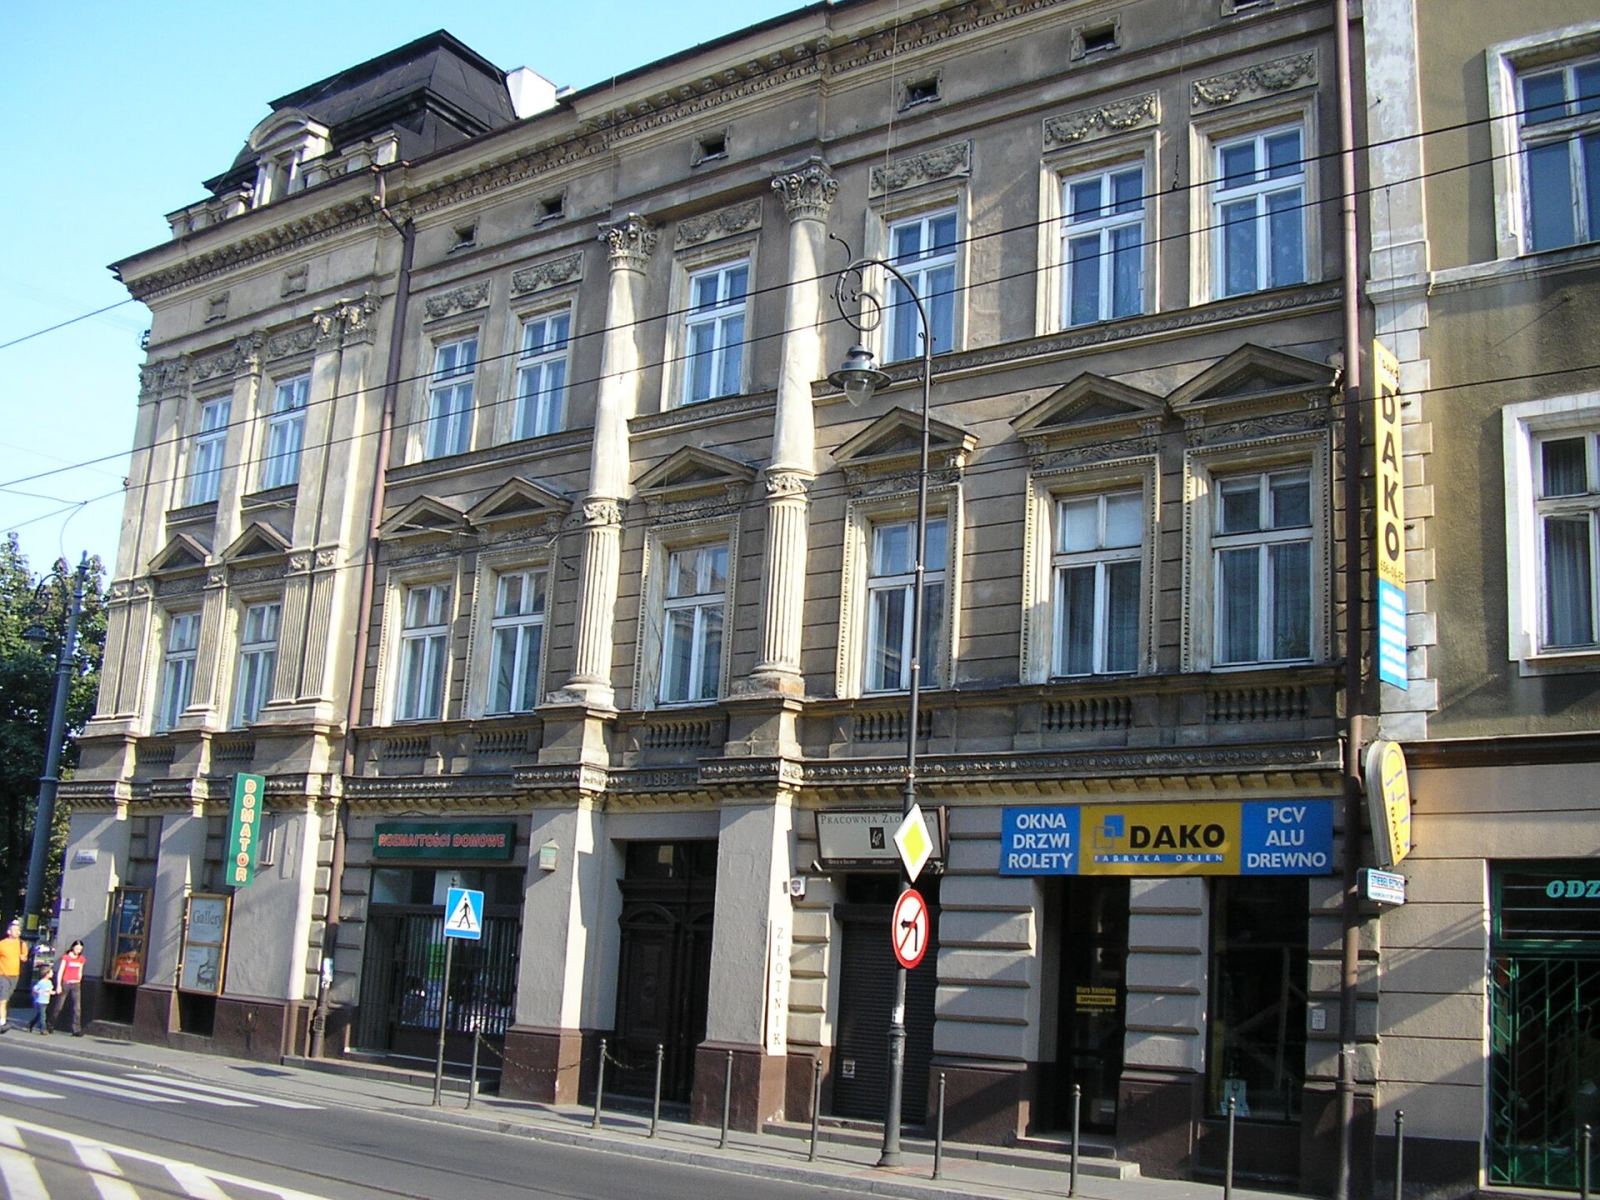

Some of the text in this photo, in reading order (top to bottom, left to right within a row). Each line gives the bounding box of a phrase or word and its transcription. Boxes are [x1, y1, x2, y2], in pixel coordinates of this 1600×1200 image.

[1381, 384, 1401, 561] DAKO
[820, 814, 878, 825] PRACOWNIA
[1016, 813, 1067, 829] OKNA
[1267, 806, 1307, 824] PCV
[235, 779, 257, 882] DOMATOR
[1129, 824, 1225, 848] DAKO
[1265, 829, 1305, 846] ALU
[378, 831, 451, 848] ROZMAITOŚCI
[1012, 833, 1070, 849] DRZWI
[1008, 853, 1073, 869] ROLETY
[1094, 854, 1223, 862] FABRYKA OKIEN
[1247, 852, 1327, 868] DREWNO
[193, 910, 221, 928] Gallery
[773, 927, 784, 1045] ZŁOTNIK
